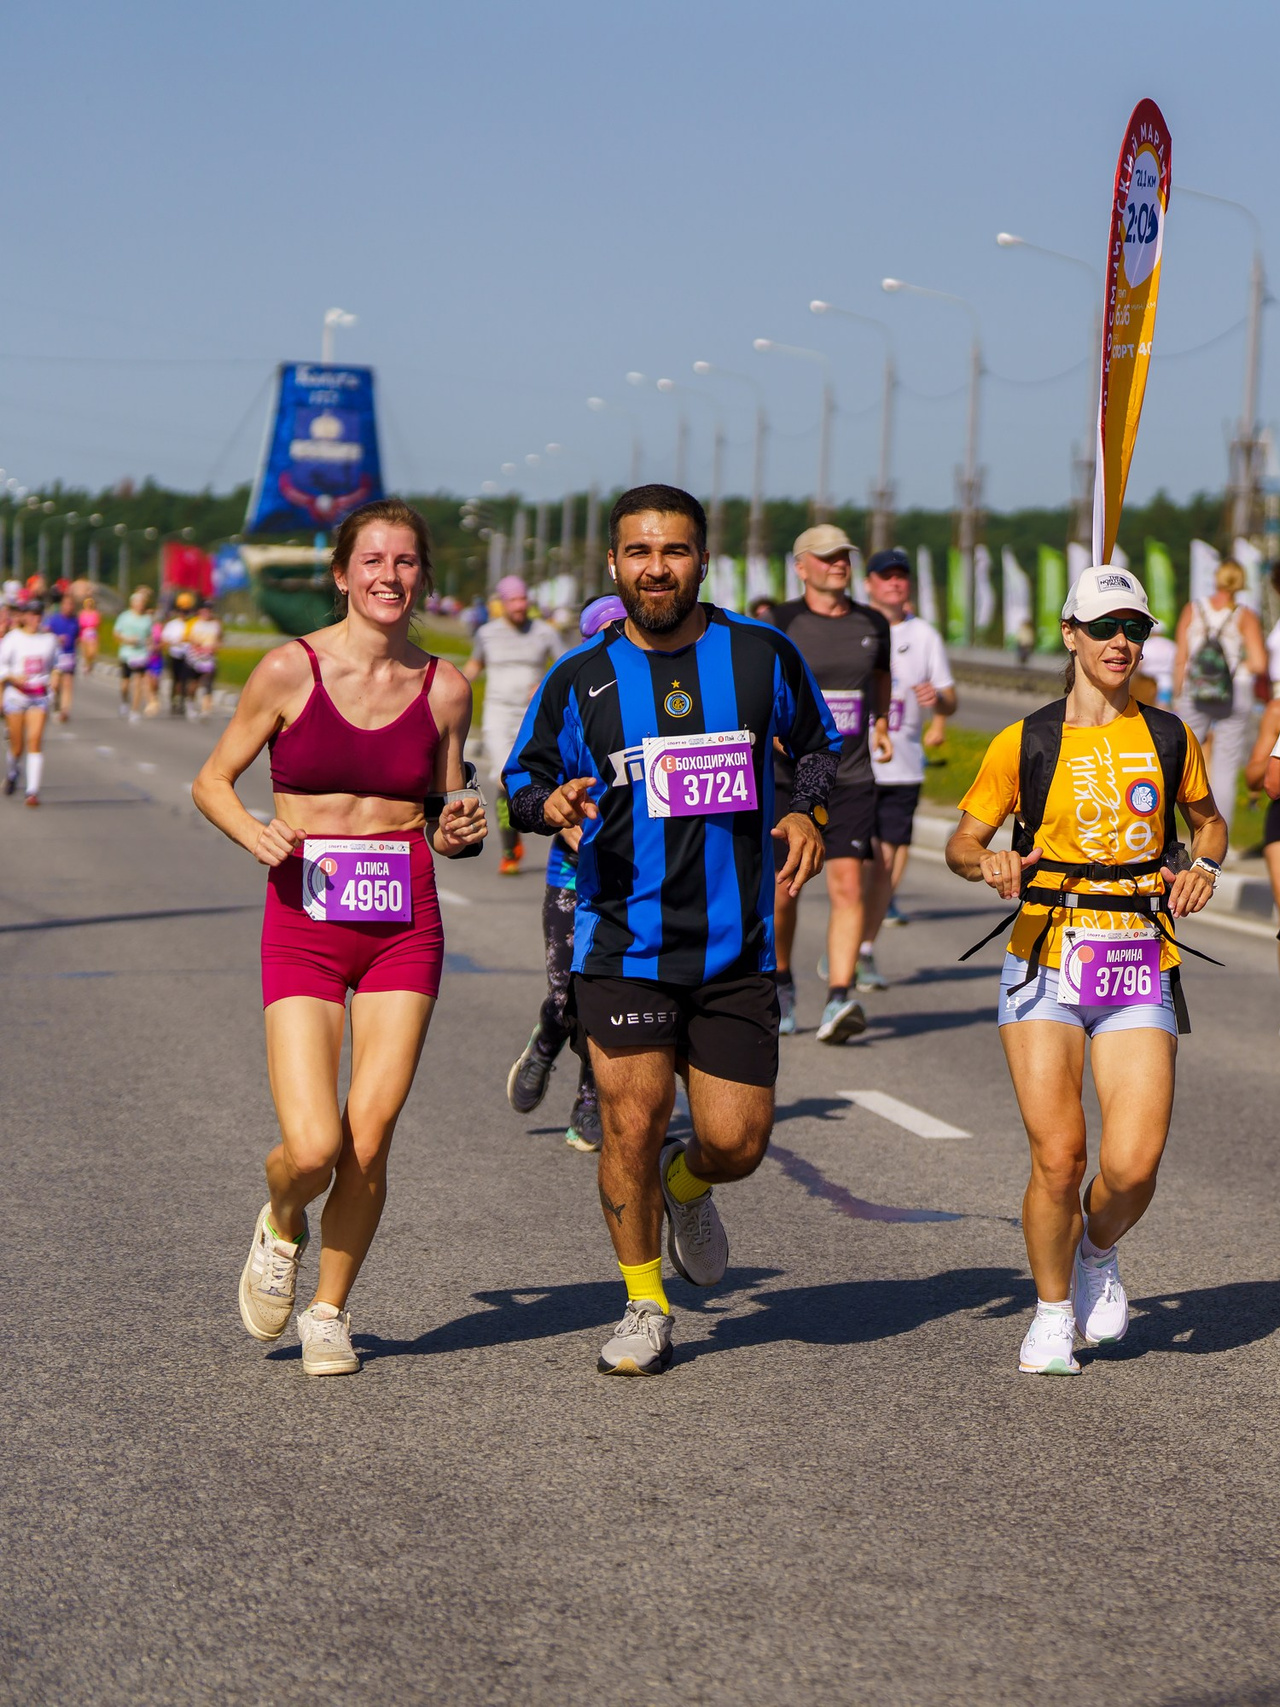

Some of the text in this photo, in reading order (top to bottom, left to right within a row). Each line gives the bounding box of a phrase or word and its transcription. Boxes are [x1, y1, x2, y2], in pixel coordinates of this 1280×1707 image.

[675, 752, 747, 771] БОХОДИРЖОН
[683, 770, 748, 807] 3724
[355, 861, 390, 876] АЛИСА
[340, 879, 403, 912] 4950
[1106, 948, 1143, 963] МАРИНА
[1095, 965, 1152, 997] 3796
